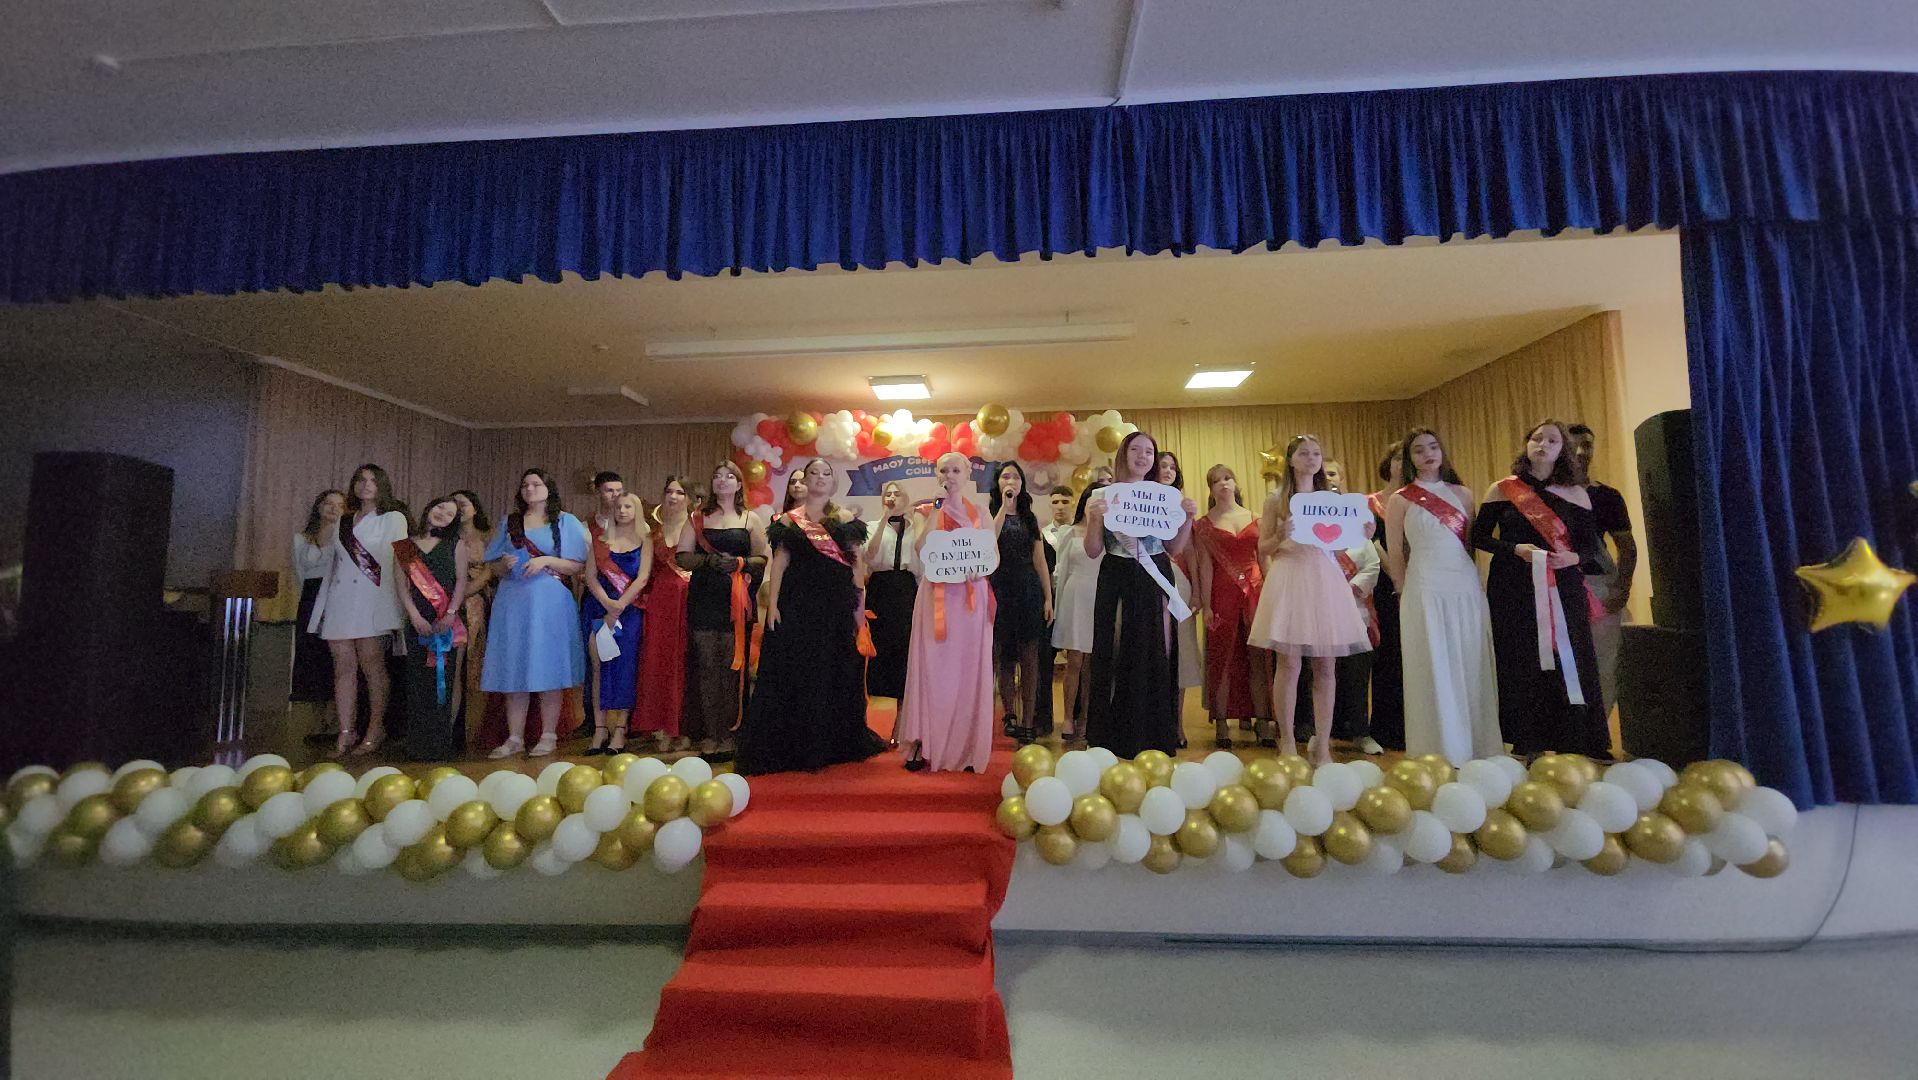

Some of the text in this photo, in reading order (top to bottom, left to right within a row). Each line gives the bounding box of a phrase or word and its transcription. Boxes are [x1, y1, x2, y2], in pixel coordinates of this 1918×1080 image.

[873, 459, 904, 473] МАОУ
[905, 467, 932, 476] СОШ
[1132, 489, 1166, 502] МЫ В
[1123, 502, 1168, 516] ВАШИХ
[1302, 504, 1358, 518] ШКОЛА
[1115, 514, 1171, 530] СЕРДЦАХ
[952, 538, 972, 548] МЫ
[941, 550, 981, 562] БУДЕМ
[935, 564, 989, 577] СКУЧАТЬ
